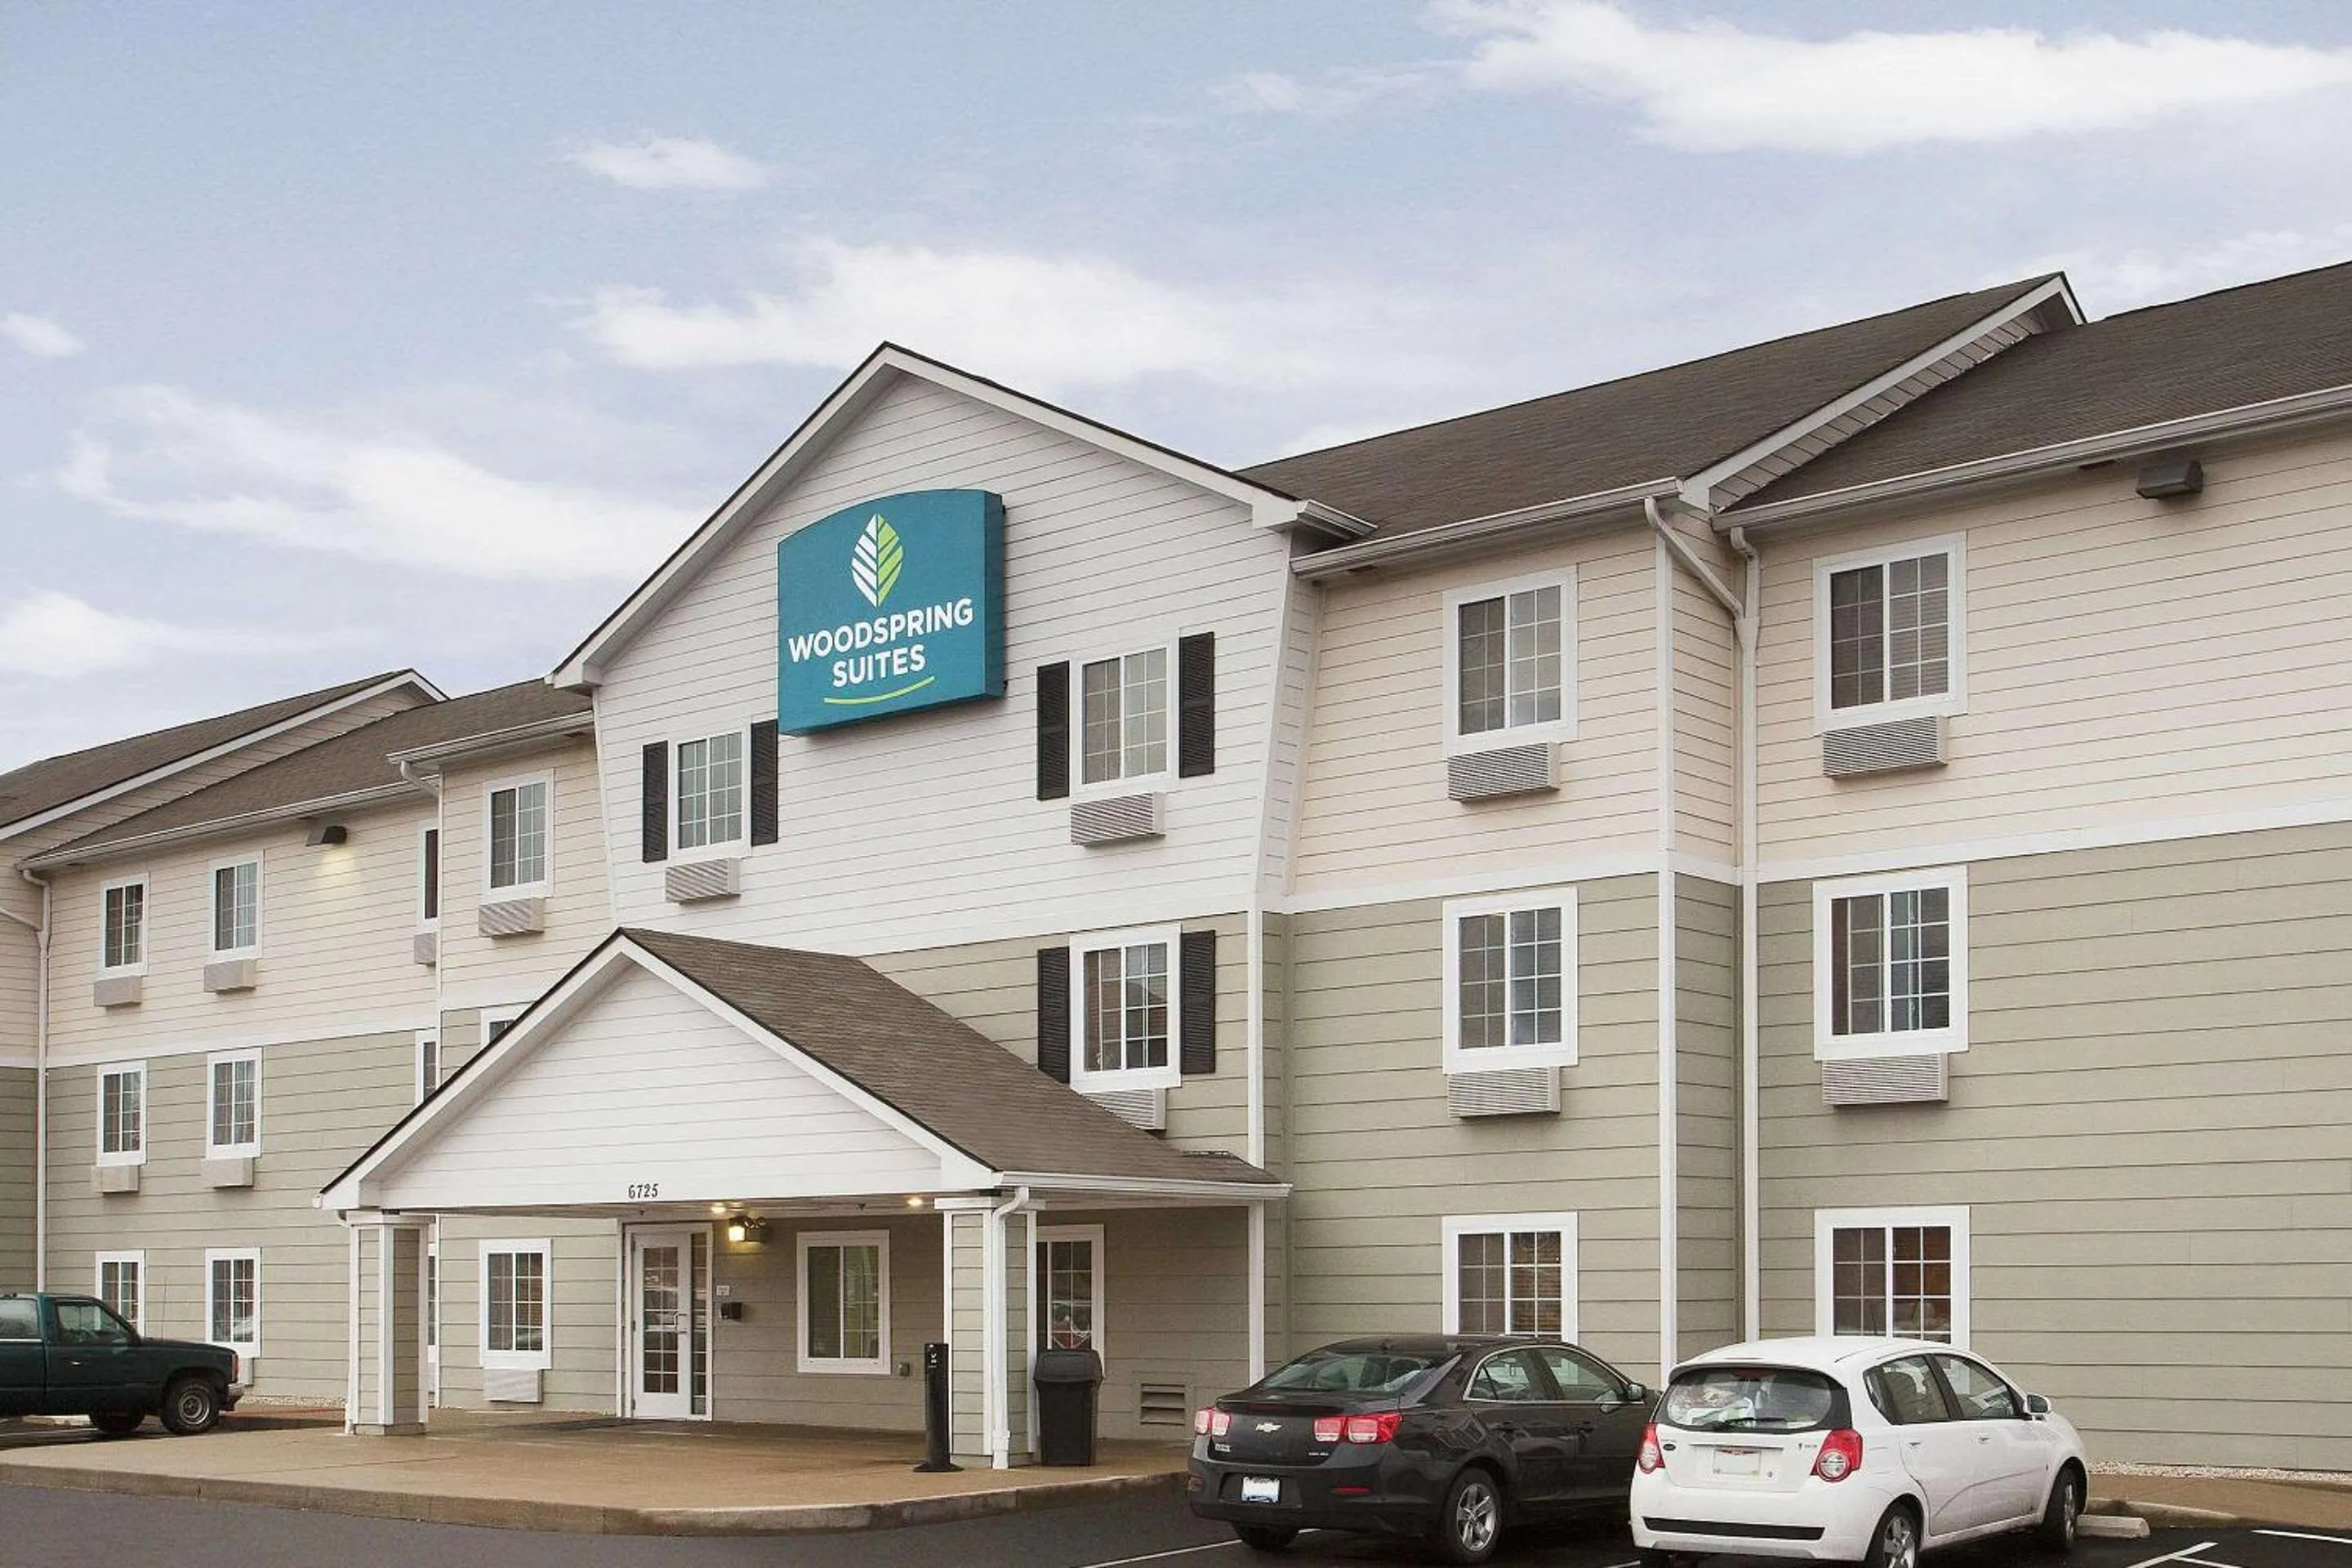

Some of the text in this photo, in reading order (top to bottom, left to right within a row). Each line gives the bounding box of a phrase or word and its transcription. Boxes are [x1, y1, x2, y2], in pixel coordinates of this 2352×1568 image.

[788, 598, 973, 663] WOODSPRING
[832, 644, 926, 688] SUITES
[628, 1183, 658, 1199] 6725
